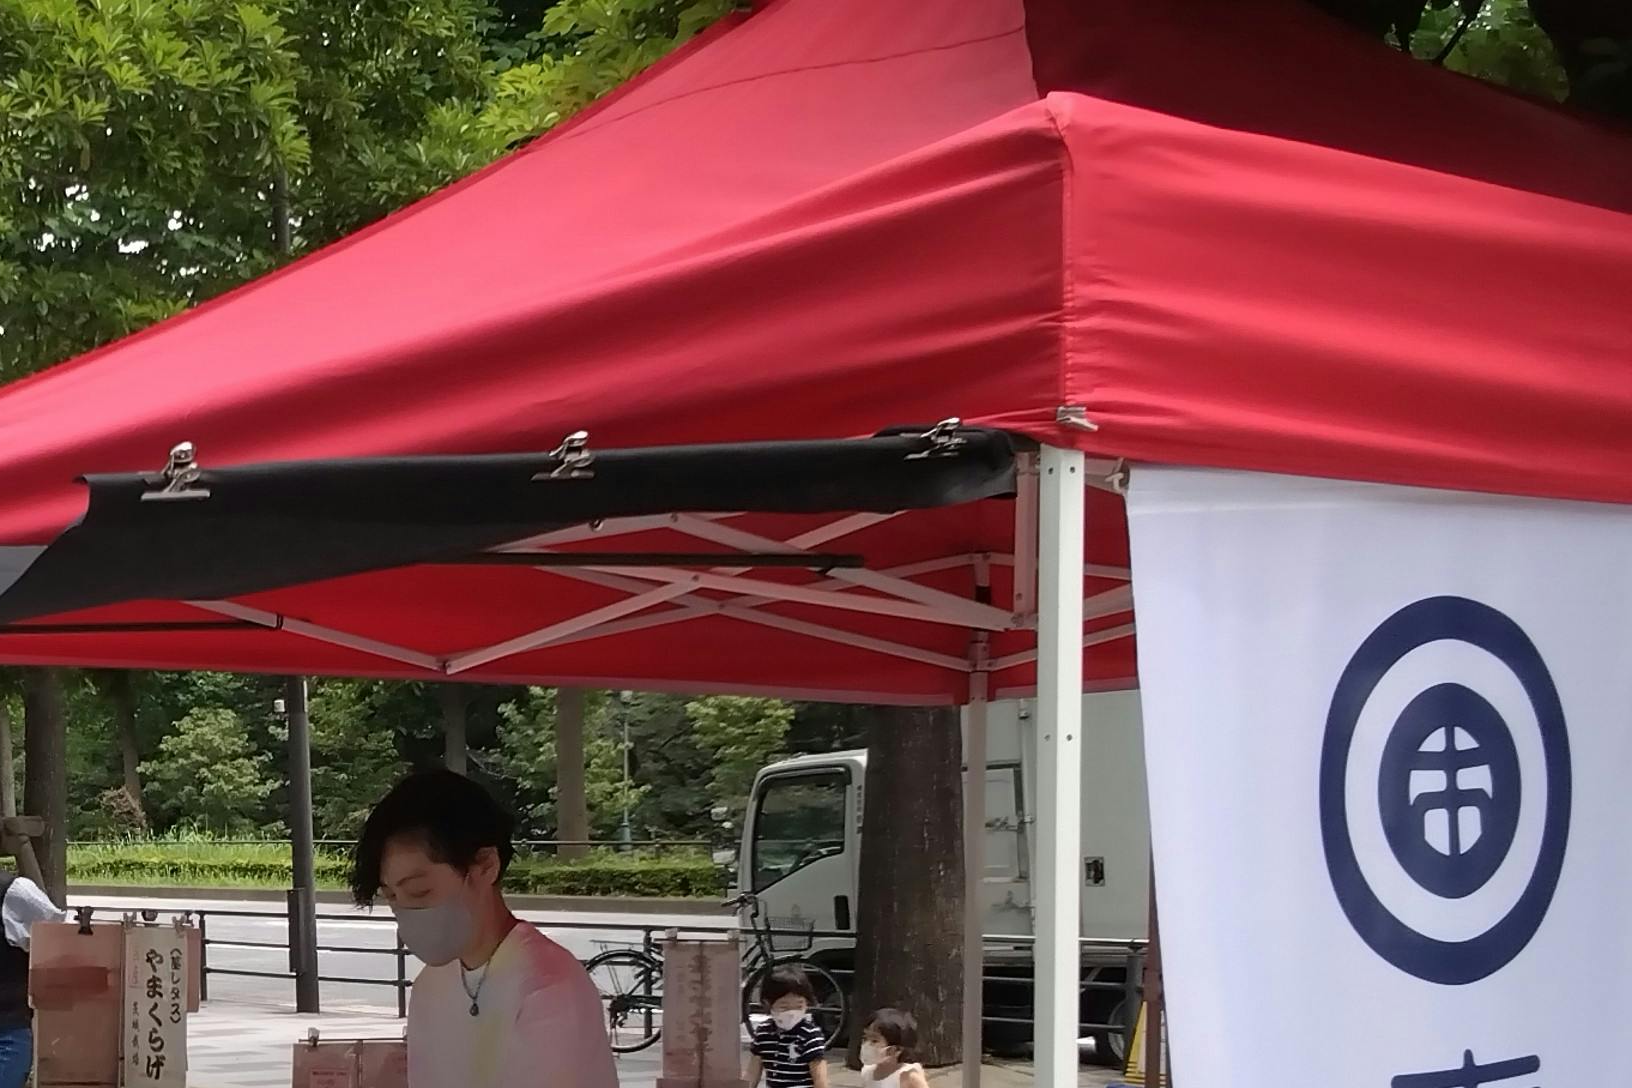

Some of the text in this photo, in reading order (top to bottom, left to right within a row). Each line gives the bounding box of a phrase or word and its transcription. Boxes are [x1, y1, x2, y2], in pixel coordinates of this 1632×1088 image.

[145, 948, 166, 1080] やまくらげ
